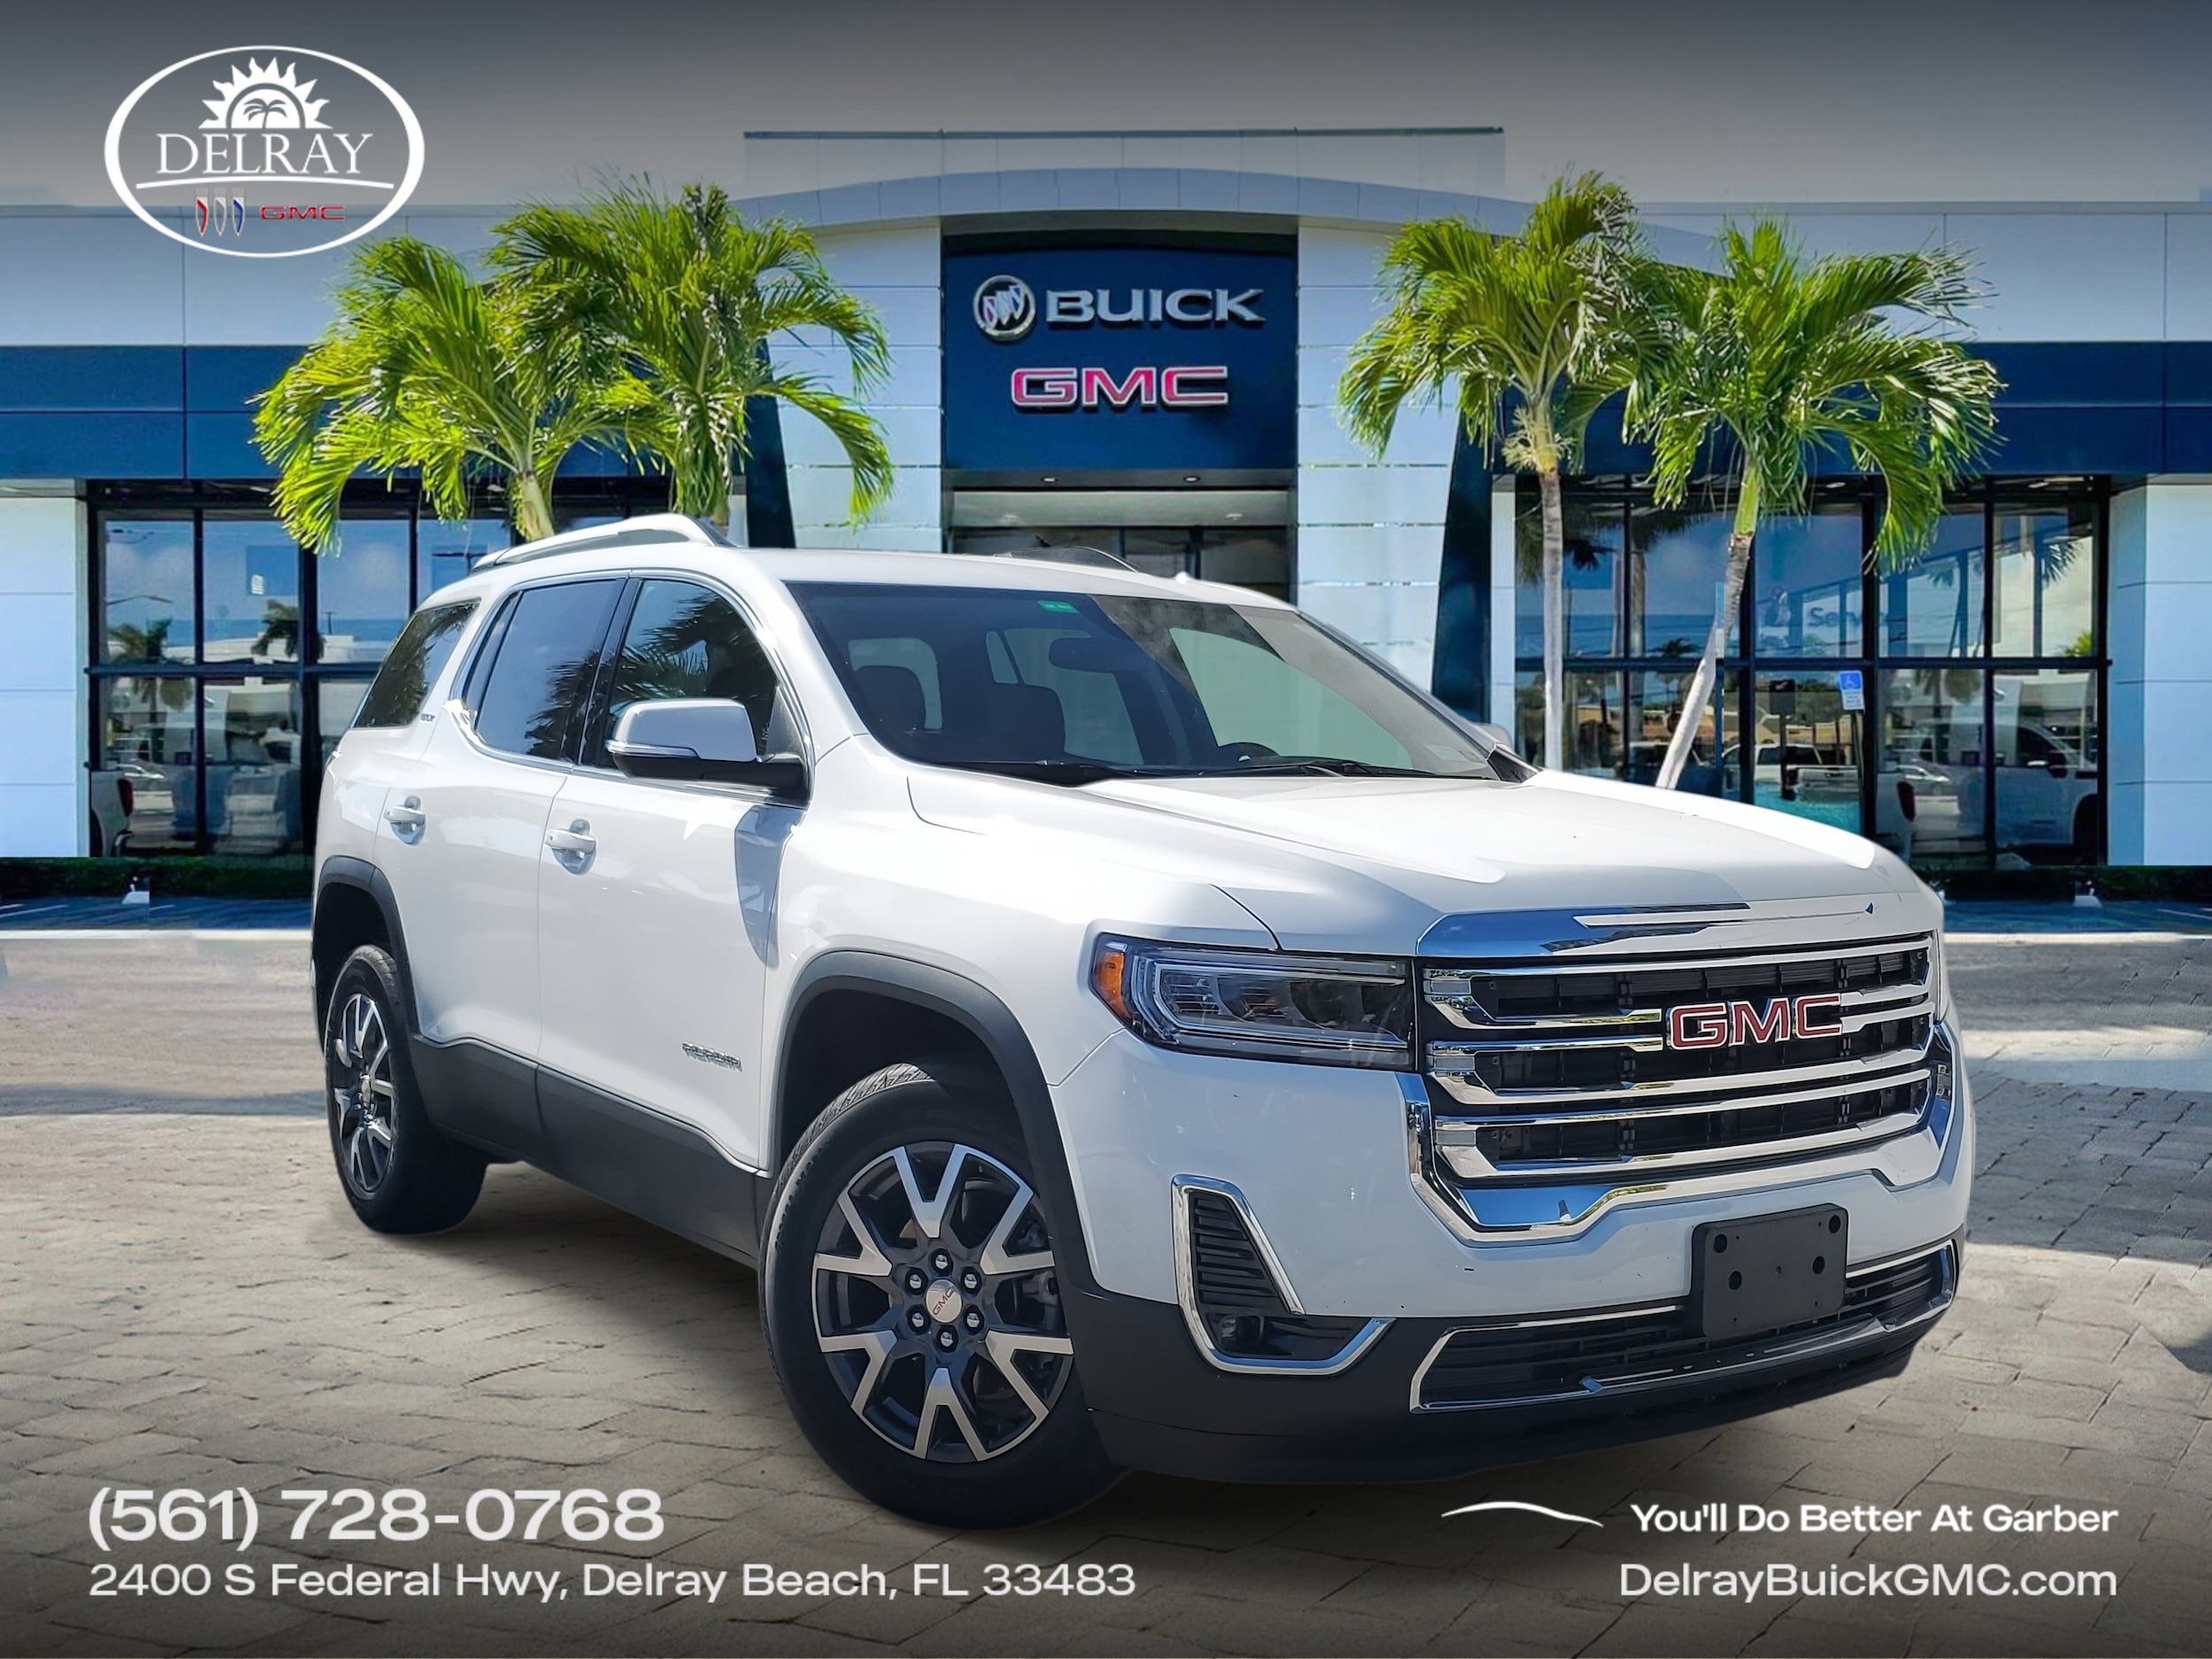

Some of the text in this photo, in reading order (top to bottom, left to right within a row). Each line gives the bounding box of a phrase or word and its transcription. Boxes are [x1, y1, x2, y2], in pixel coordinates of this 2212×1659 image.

[1046, 288, 1265, 323] BUICK
[1011, 366, 1228, 406] GMC
[1666, 993, 1843, 1050] GMC
[932, 1286, 956, 1317] GMC
